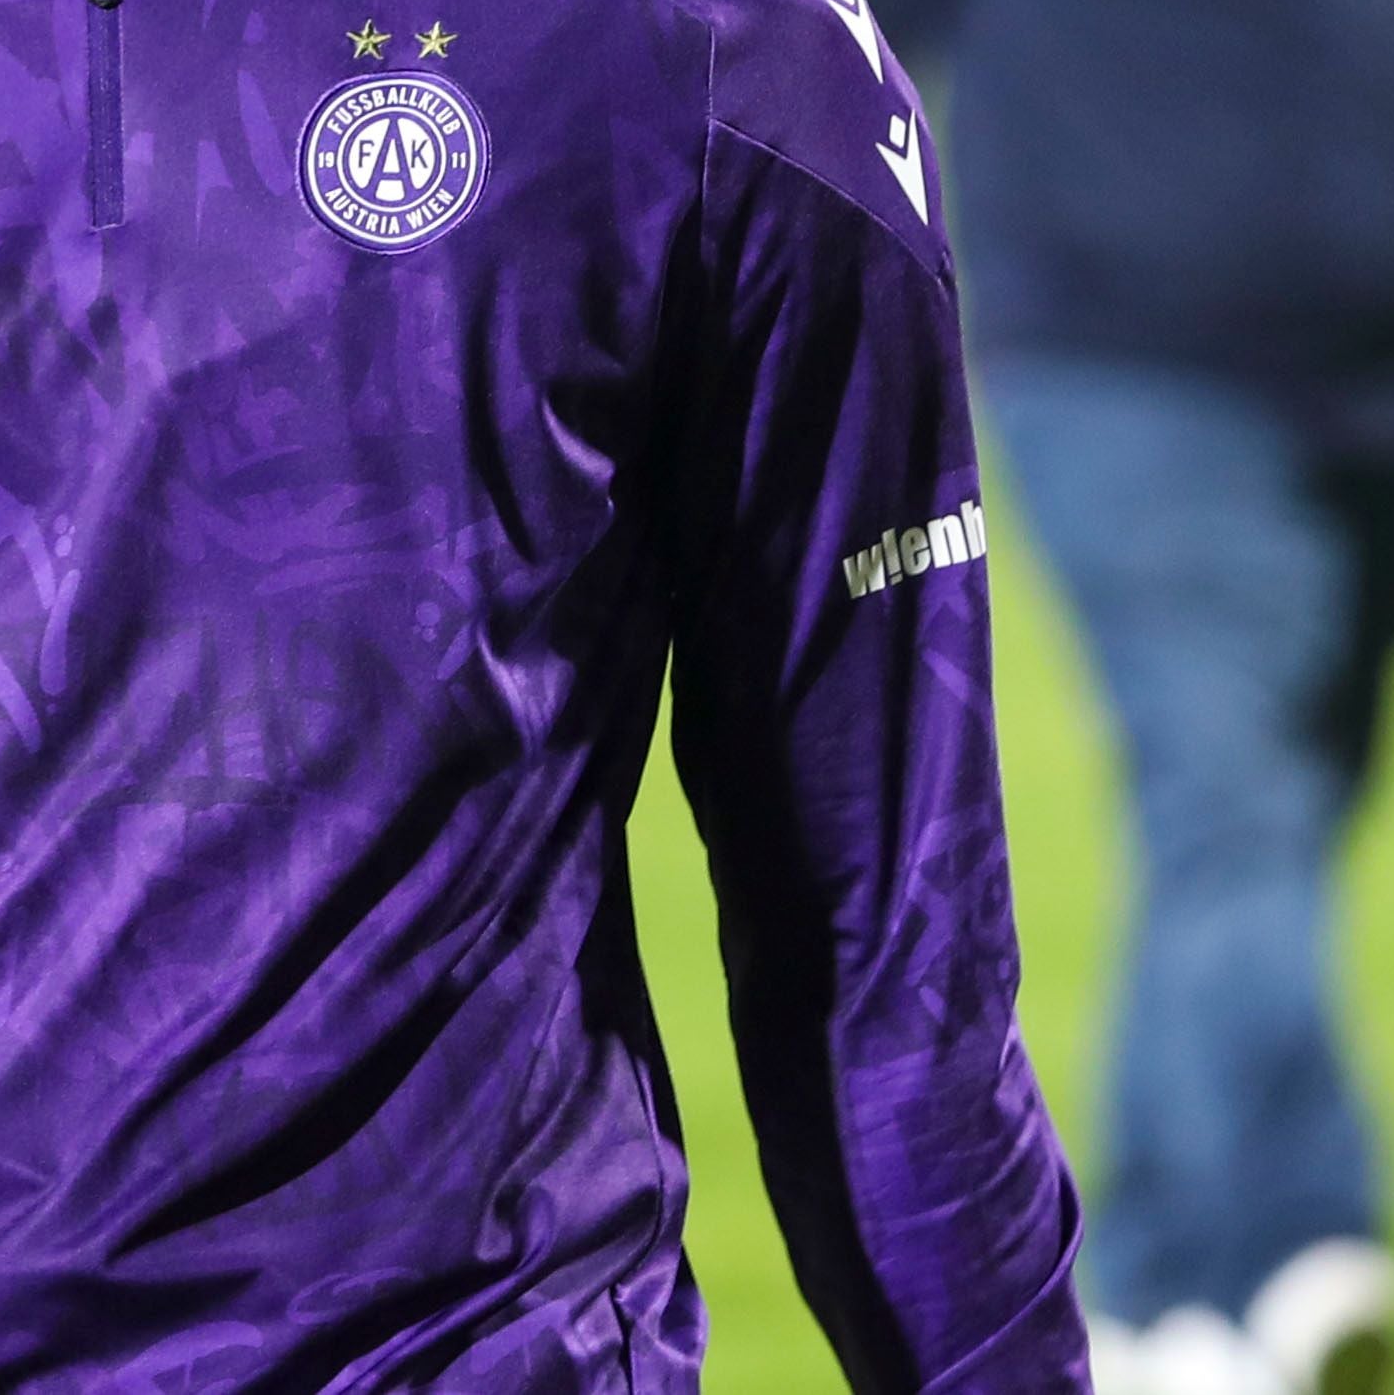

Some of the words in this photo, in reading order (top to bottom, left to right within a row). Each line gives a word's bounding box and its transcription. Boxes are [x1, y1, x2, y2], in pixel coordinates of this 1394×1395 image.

[327, 86, 461, 135] FUSSBALLKLUB
[317, 151, 336, 169] 19
[451, 151, 467, 169] 11
[324, 187, 401, 235] AUSTRIA
[405, 188, 454, 231] WIEN
